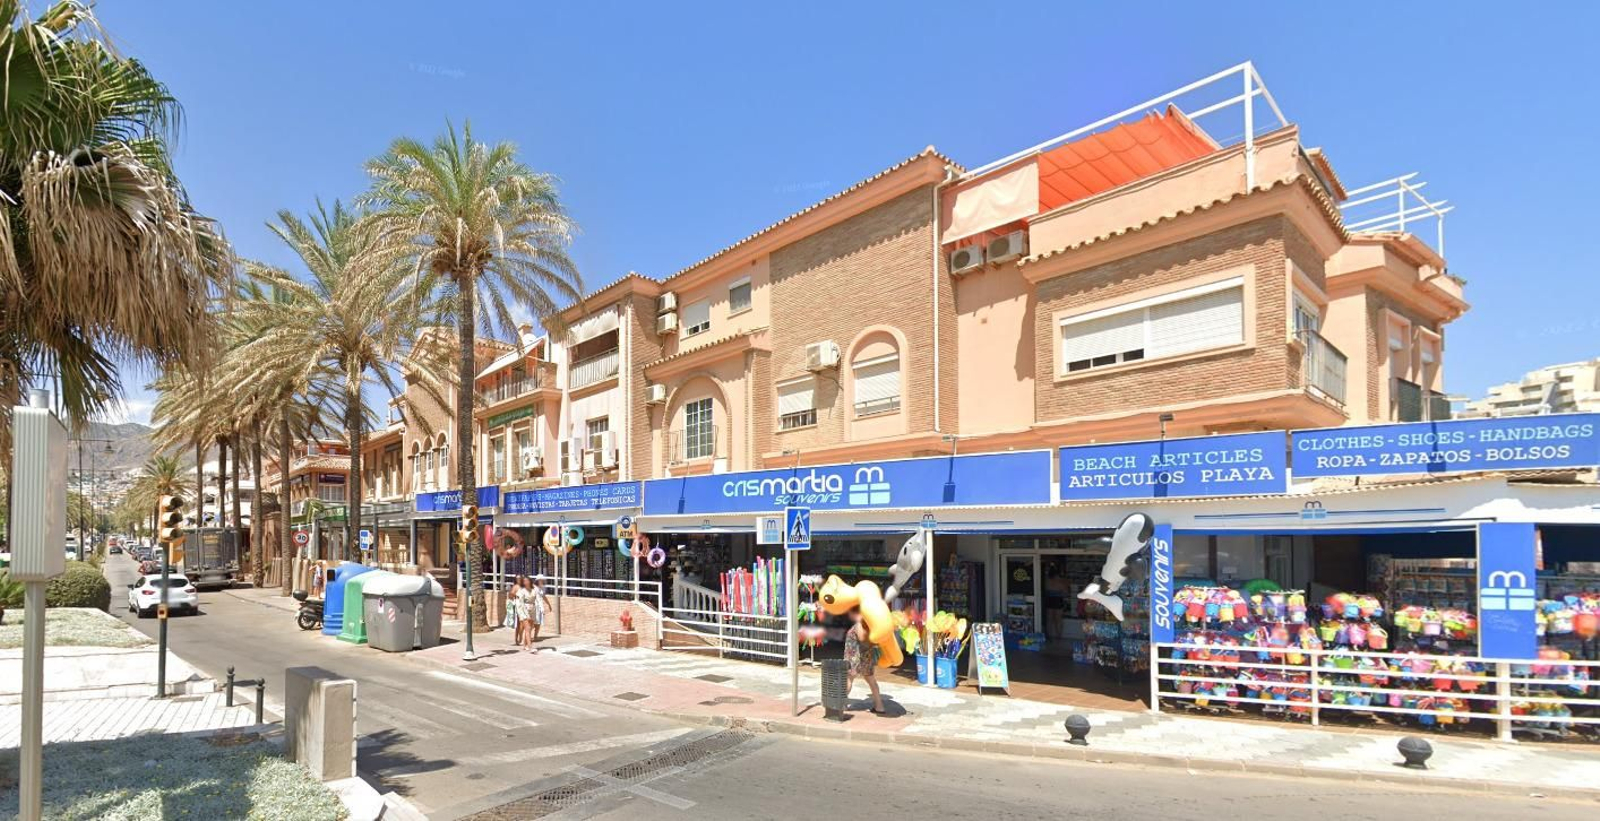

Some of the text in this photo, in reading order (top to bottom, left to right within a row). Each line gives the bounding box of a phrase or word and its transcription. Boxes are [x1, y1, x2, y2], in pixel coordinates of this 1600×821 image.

[1073, 448, 1263, 471] BEACH ARTICLES
[722, 469, 843, 498] crismartia
[1068, 466, 1275, 488] ARTICULOS PLAYA
[773, 492, 843, 505] souvenirs
[1153, 538, 1170, 630] souvenirs
